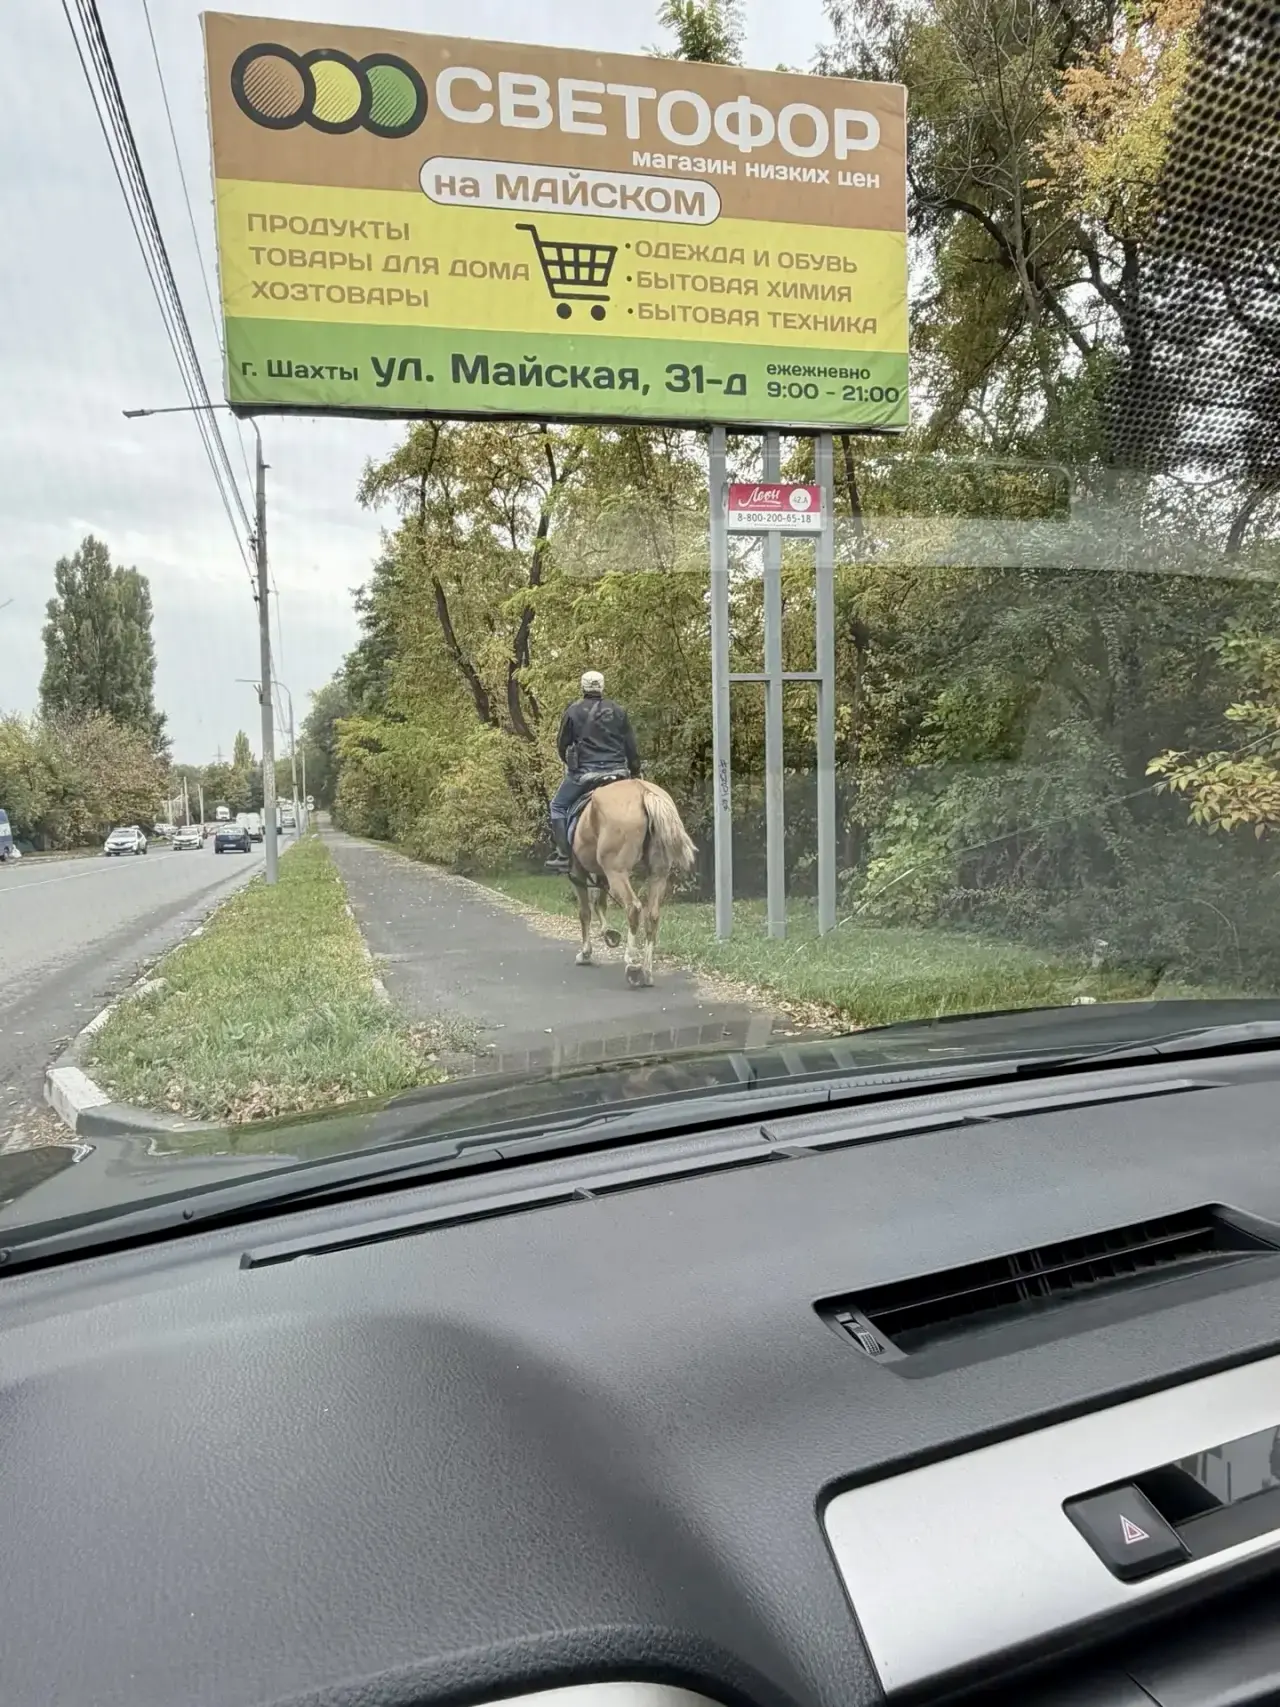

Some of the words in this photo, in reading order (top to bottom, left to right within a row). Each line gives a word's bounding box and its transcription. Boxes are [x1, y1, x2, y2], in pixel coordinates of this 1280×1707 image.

[435, 66, 881, 159] СВЕТОФОР
[632, 150, 737, 176] магазин
[745, 162, 830, 184] низких
[837, 171, 881, 188] цен
[434, 174, 481, 198] на
[495, 171, 706, 216] МАЙСКОМ
[247, 213, 410, 241] ПРОДУКТЫ
[248, 246, 373, 272] ТОВАРЫ
[381, 254, 440, 276] ДЛЯ
[448, 259, 531, 281] ДОМА
[634, 239, 746, 266] ОДЕЖДА
[752, 250, 771, 269] И
[777, 252, 859, 274] ОБУВЬ
[250, 279, 430, 308] ХОЗТОВАРЫ
[636, 271, 759, 297] БЫТОВАЯ
[766, 280, 853, 303] ХИМИЯ
[637, 303, 760, 328] БЫТОВАЯ
[767, 311, 878, 335] ТЕХНИКА
[241, 362, 258, 377] г.
[266, 359, 359, 382] Шахты
[370, 355, 435, 388] ул.
[450, 353, 651, 396] Майская,
[664, 363, 748, 396] 31-д
[766, 381, 820, 400] 9:00
[841, 385, 901, 404] 21:00
[737, 513, 811, 523] 8-800-200-65-18
